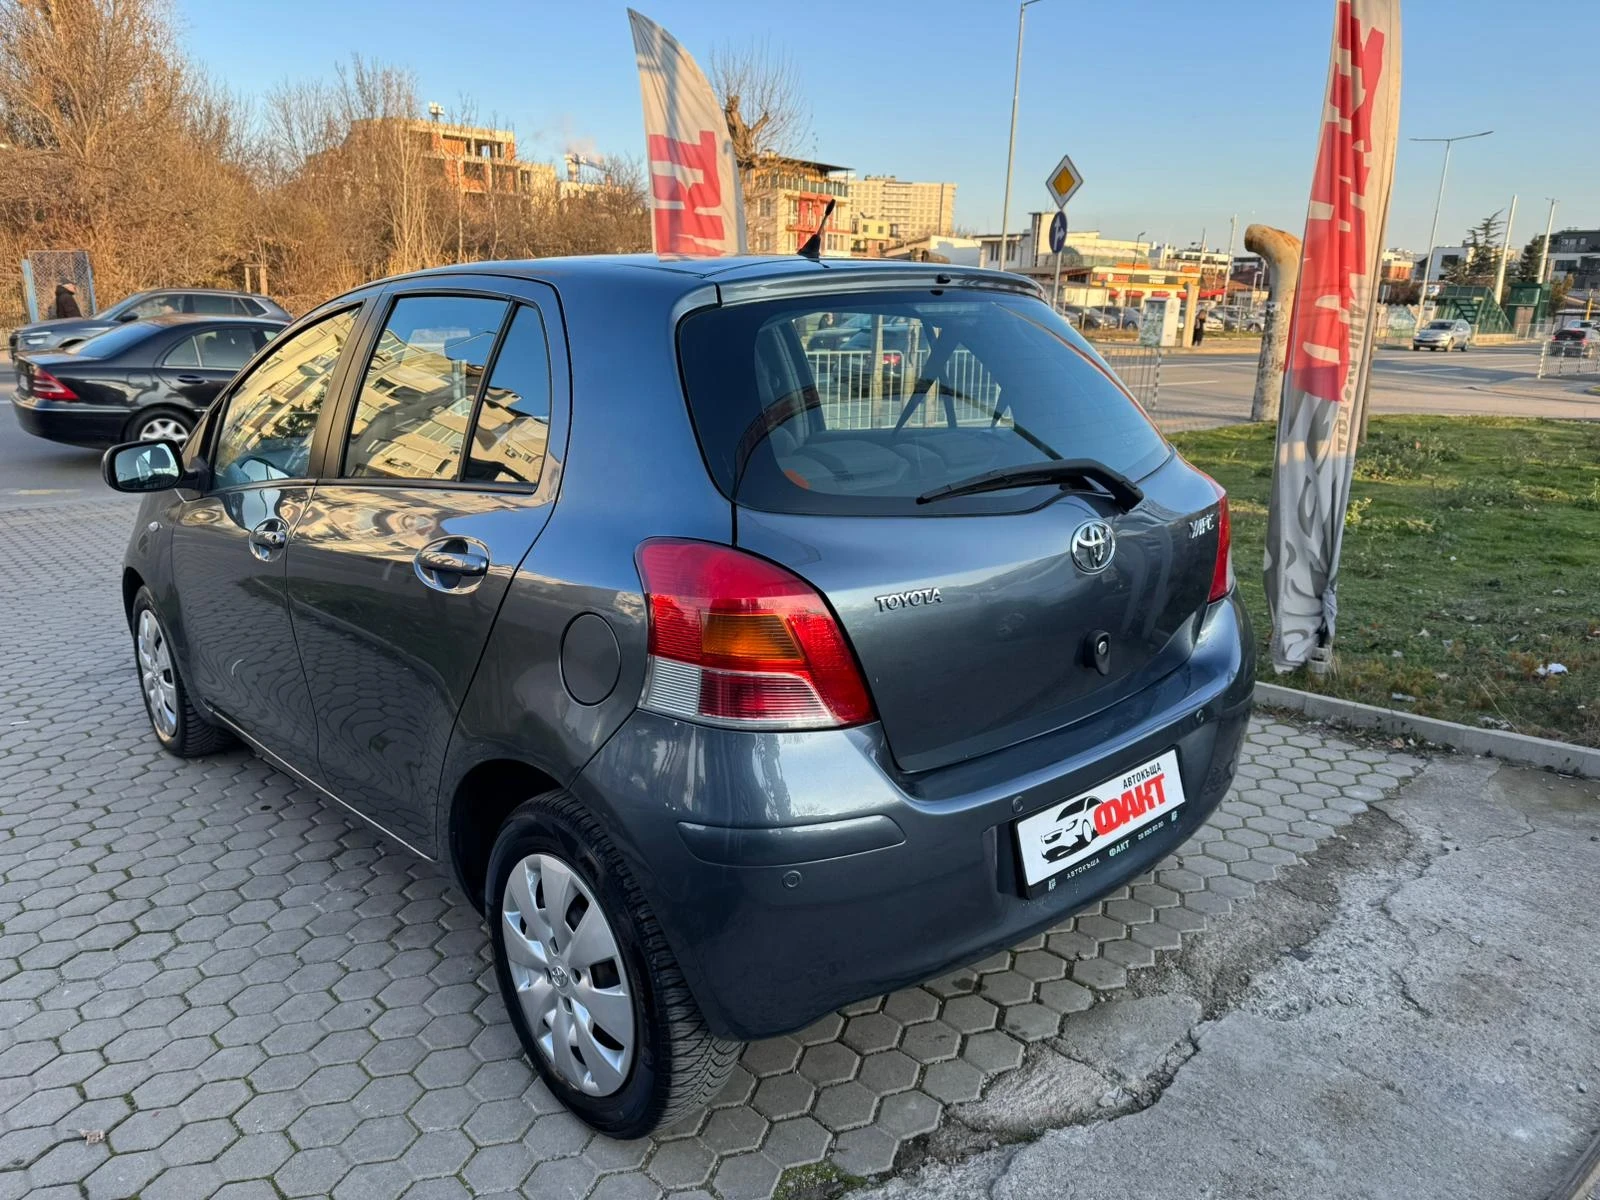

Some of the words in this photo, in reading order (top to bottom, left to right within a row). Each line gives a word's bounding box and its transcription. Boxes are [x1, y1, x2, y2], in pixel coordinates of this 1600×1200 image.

[874, 586, 943, 612] TOYOTA
[1122, 762, 1162, 789] АВТОКЪЩА
[1093, 773, 1166, 836] ФАКТ
[1108, 839, 1130, 857] ФАКТ
